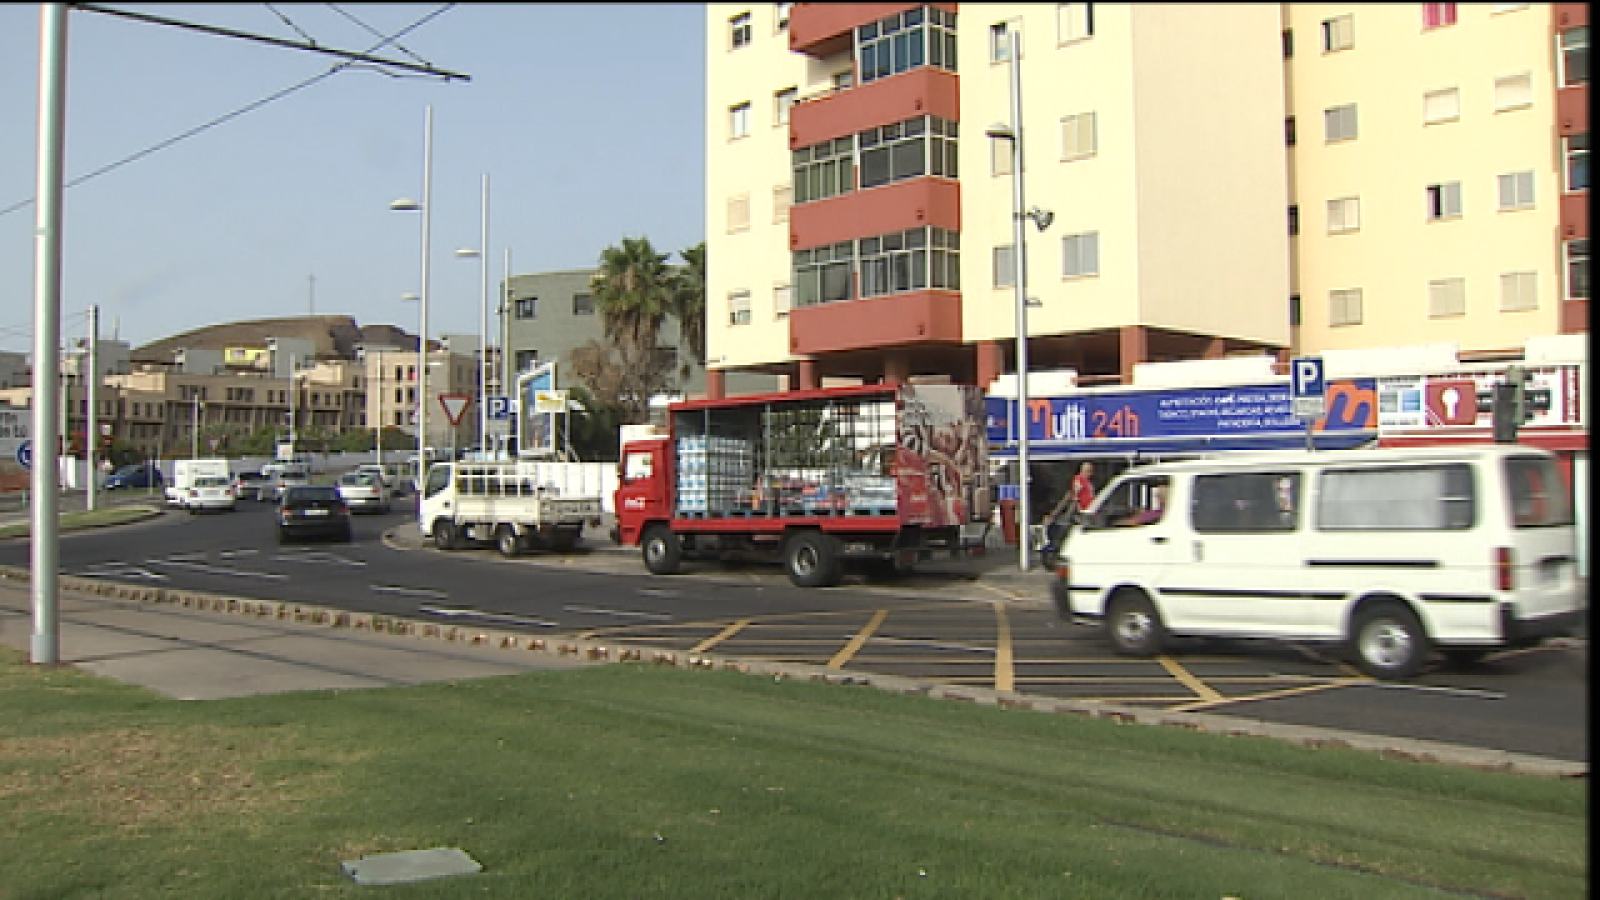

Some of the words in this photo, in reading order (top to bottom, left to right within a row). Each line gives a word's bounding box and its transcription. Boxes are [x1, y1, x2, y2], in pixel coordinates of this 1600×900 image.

[1298, 362, 1318, 394] P
[490, 399, 506, 416] P
[1091, 405, 1139, 438] 24h
